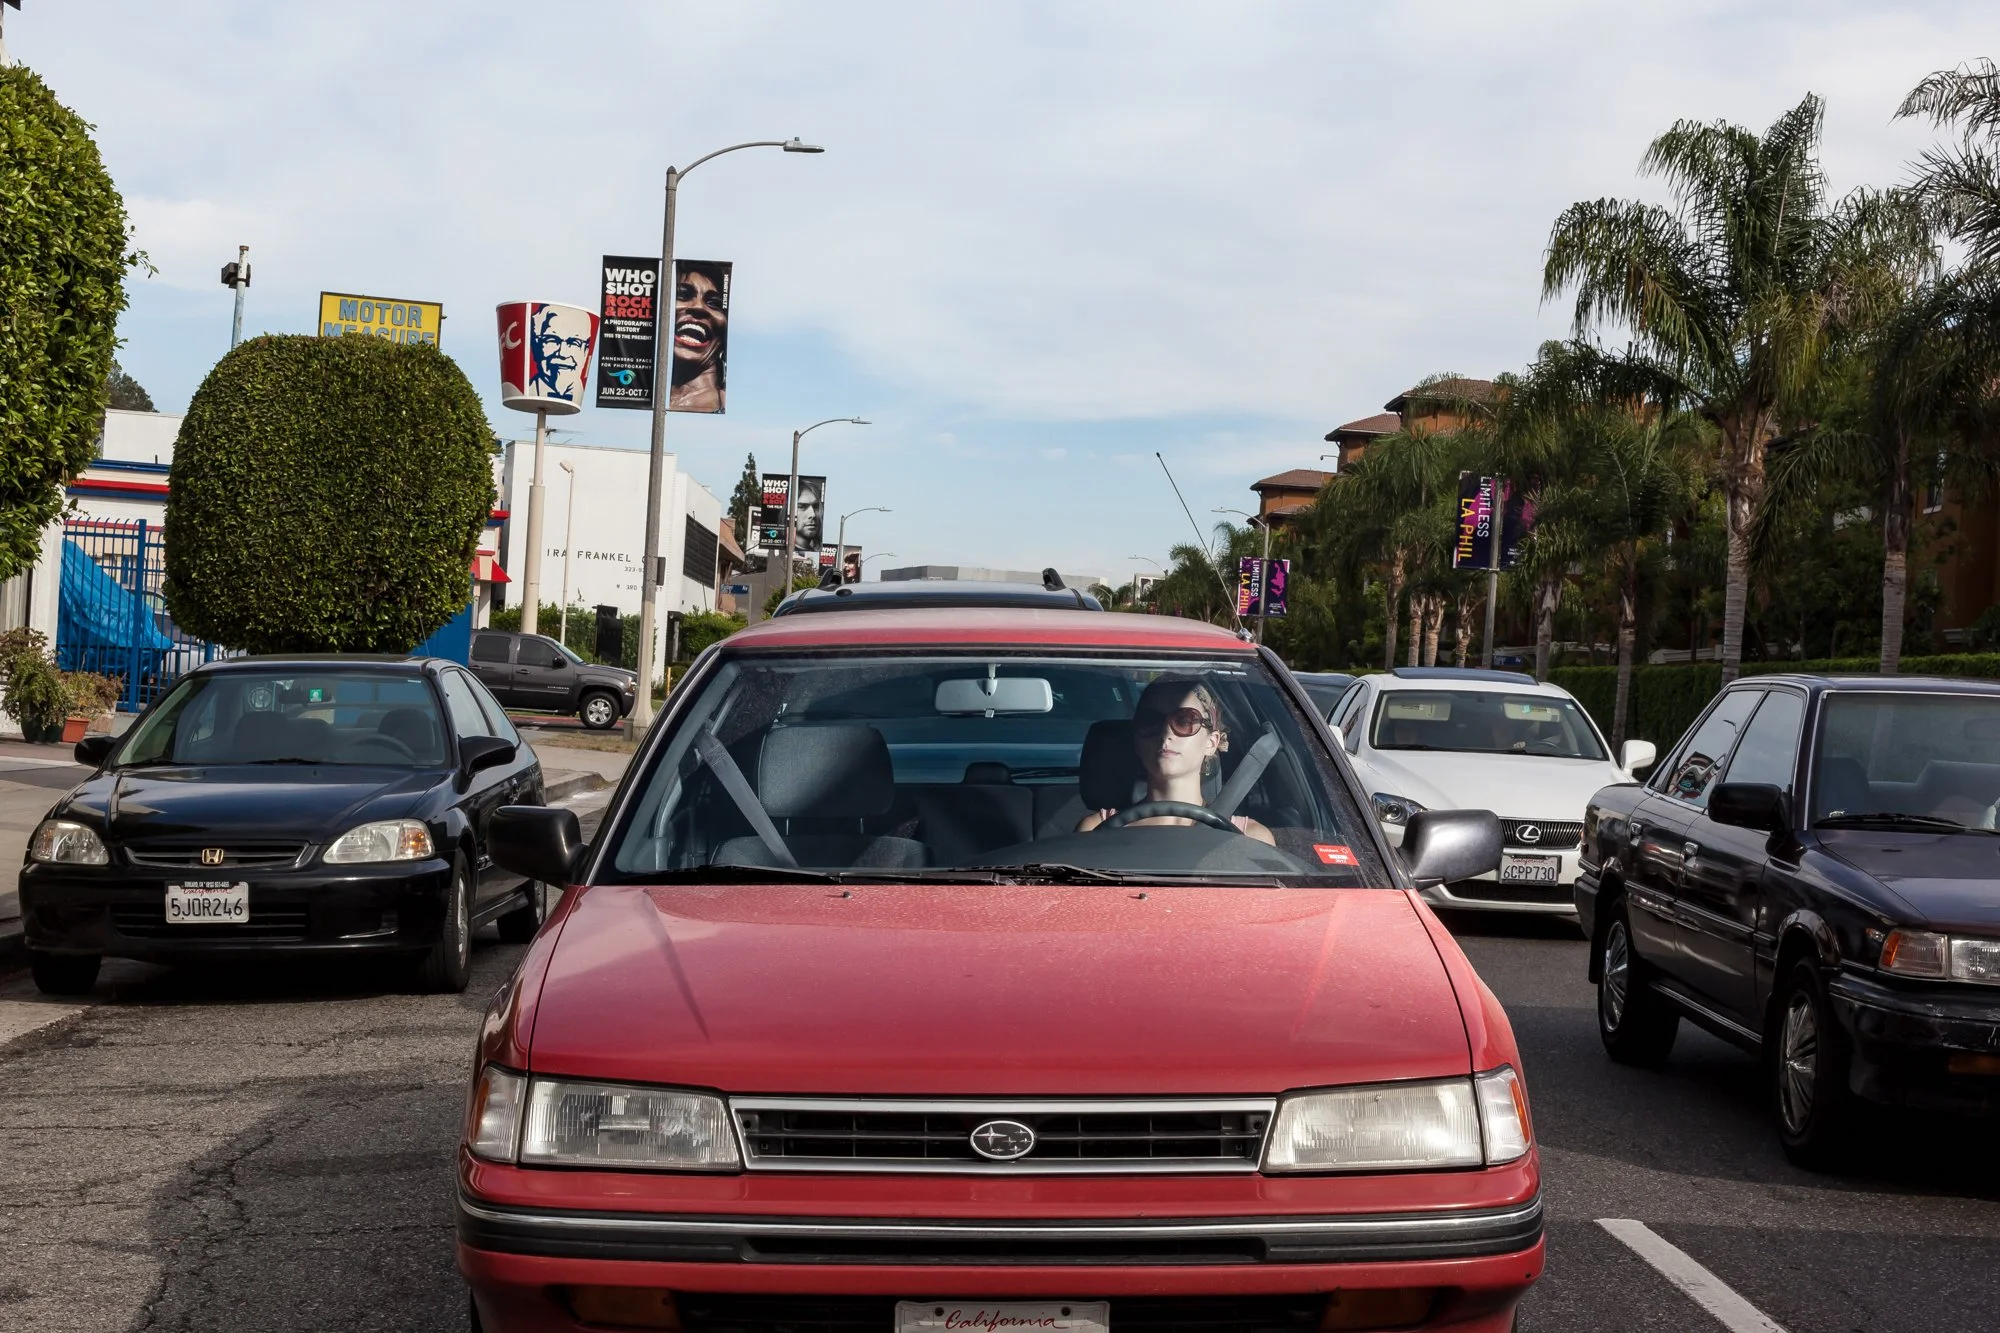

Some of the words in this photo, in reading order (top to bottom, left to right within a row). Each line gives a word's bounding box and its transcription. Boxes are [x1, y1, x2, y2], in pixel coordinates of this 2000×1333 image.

[605, 268, 656, 284] WHO
[605, 282, 653, 296] SHOT
[605, 295, 652, 308] ROCK
[339, 299, 423, 328] MOTOR
[500, 321, 522, 361] FC
[601, 387, 615, 395] JUN
[763, 479, 789, 487] WHO
[763, 486, 788, 494] SHOT
[1461, 498, 1476, 518] LA
[1477, 476, 1492, 537] LIMITLESS
[1457, 524, 1474, 562] PHIL
[546, 548, 567, 558] IRA
[577, 550, 632, 562] FRANKEL
[1241, 573, 1250, 585] LA
[1251, 560, 1260, 597] LIMITLESS
[1240, 588, 1250, 611] PHIL
[1503, 865, 1555, 880] 6CPP730
[945, 1309, 1069, 1332] California
